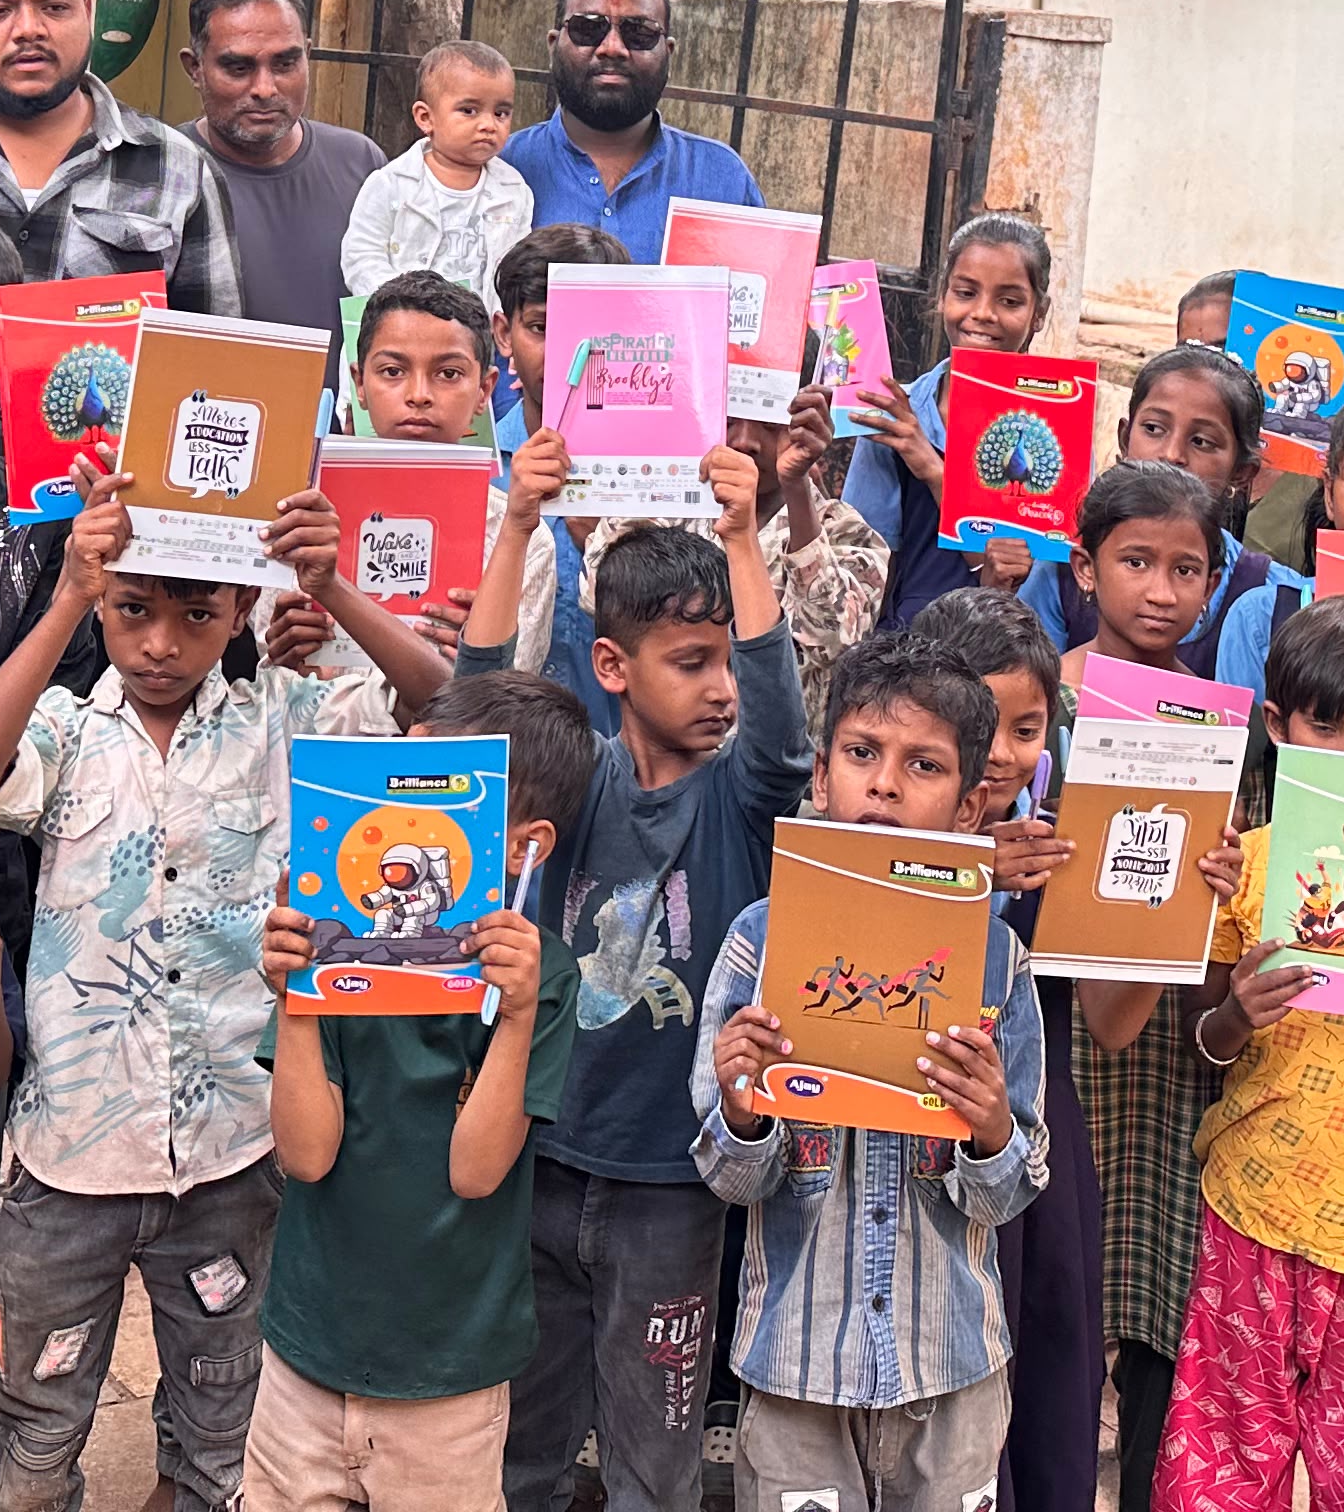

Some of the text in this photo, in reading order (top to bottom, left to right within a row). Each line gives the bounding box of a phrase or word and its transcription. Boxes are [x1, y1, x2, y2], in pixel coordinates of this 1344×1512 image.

[590, 333, 676, 349] INSPIRATIN
[595, 362, 674, 405] Brooklyn
[189, 426, 245, 443] EDUCATION
[188, 441, 211, 454] LESS
[389, 560, 428, 578] SMILE
[388, 776, 449, 790] Brilliance
[893, 860, 955, 882] Brilliance
[1116, 858, 1166, 874] EDUCATION
[334, 976, 369, 991] Ajay
[445, 978, 474, 989] GOLD
[788, 1078, 822, 1095] Ajay
[922, 1096, 947, 1109] GOLD
[646, 1305, 706, 1345] RUN
